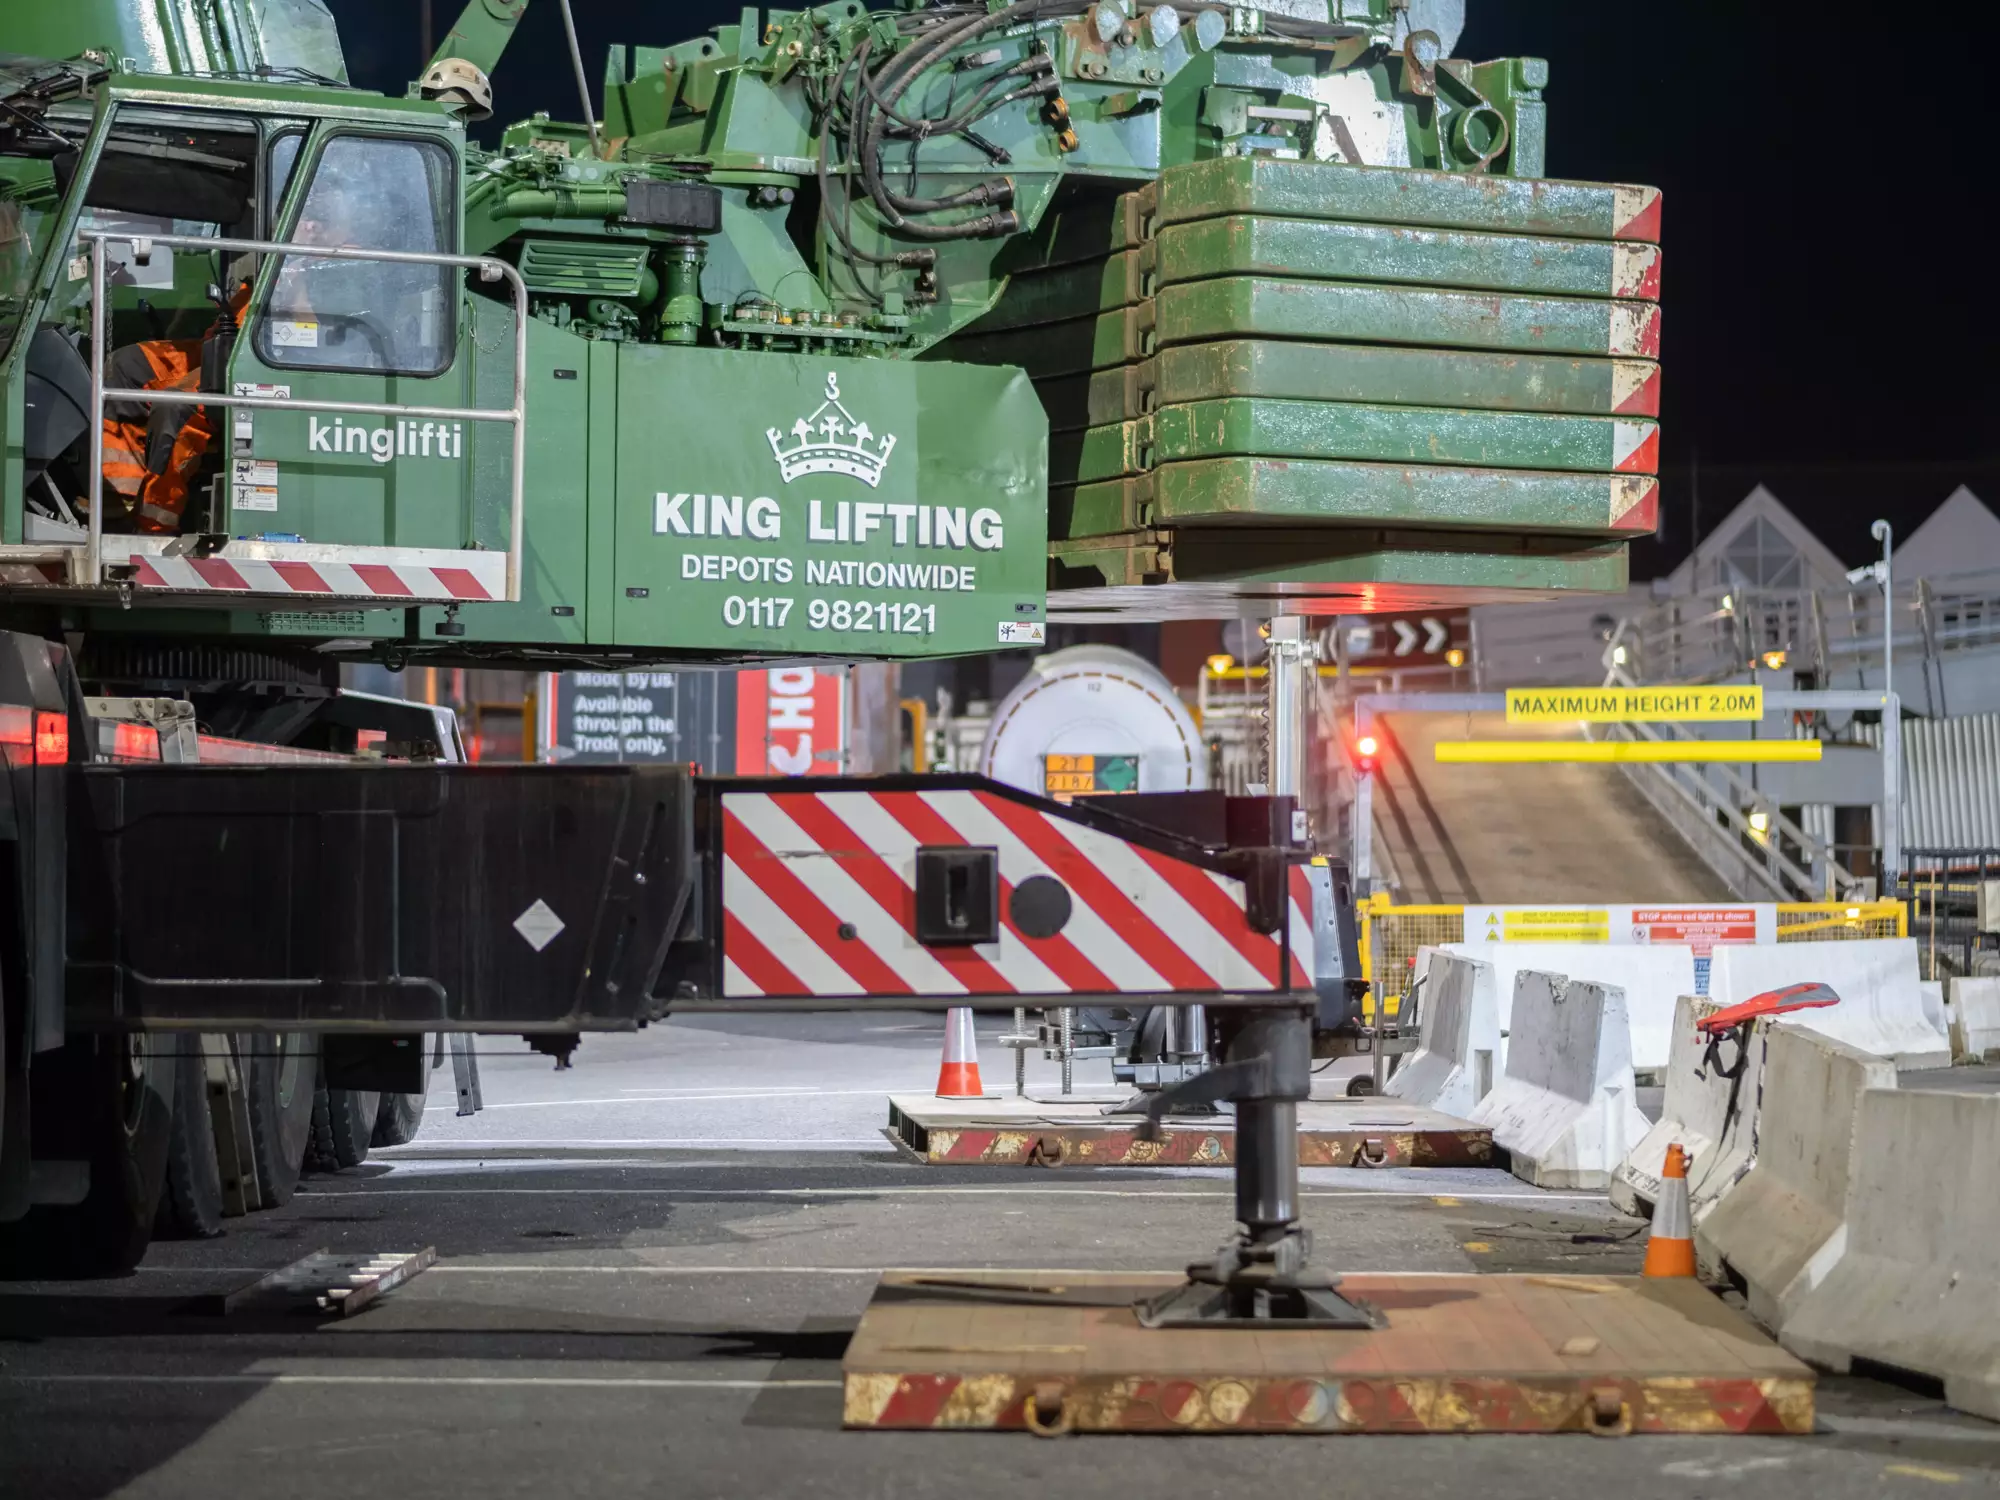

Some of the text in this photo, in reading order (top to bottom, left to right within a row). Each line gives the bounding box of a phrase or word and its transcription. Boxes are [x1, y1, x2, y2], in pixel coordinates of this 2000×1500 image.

[308, 416, 461, 463] kinglifti
[654, 492, 1003, 550] KING LIFTING
[681, 553, 976, 591] DEPOTS NATIONWIDE
[723, 596, 936, 633] 0117 9821121
[1513, 695, 1756, 714] MAXIMUM HEIGHT 2.0M
[647, 716, 674, 733] the
[626, 735, 667, 756] only.
